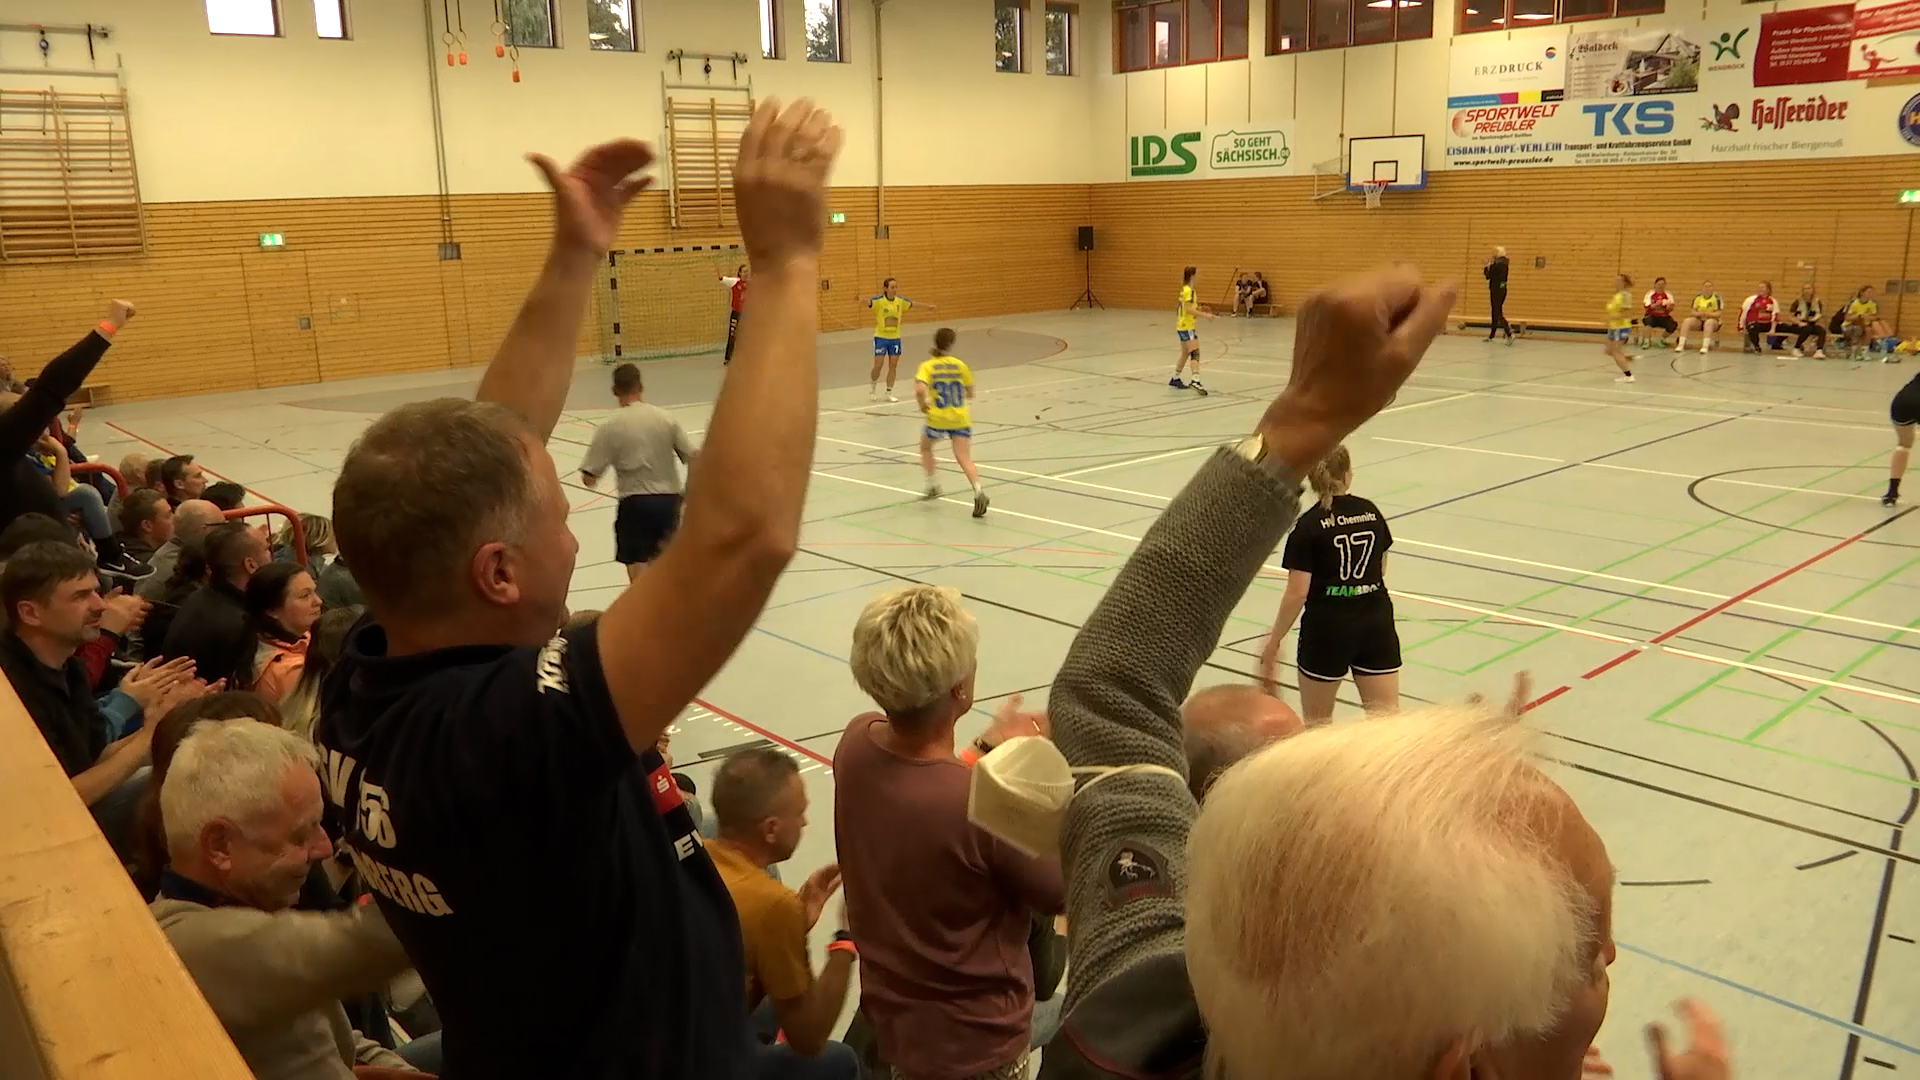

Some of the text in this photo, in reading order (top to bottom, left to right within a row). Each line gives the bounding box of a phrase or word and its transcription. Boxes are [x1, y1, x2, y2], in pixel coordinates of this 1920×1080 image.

[1474, 61, 1543, 76] ERZDRUCK
[1465, 104, 1559, 122] SPORTWELT
[1582, 100, 1674, 136] TKS
[1751, 94, 1848, 131] Hasseröder
[1234, 136, 1272, 149] SO GEHT
[1711, 142, 1750, 153] Harzhaft
[1753, 141, 1789, 151] frischer
[1131, 131, 1201, 177] IDS
[1216, 148, 1281, 163] SÄCHSISCH.
[1454, 156, 1554, 166] www.sportwelt-preussler.de
[933, 381, 963, 409] 30
[1320, 511, 1377, 529] HV Chemnitz
[1333, 530, 1376, 581] 17
